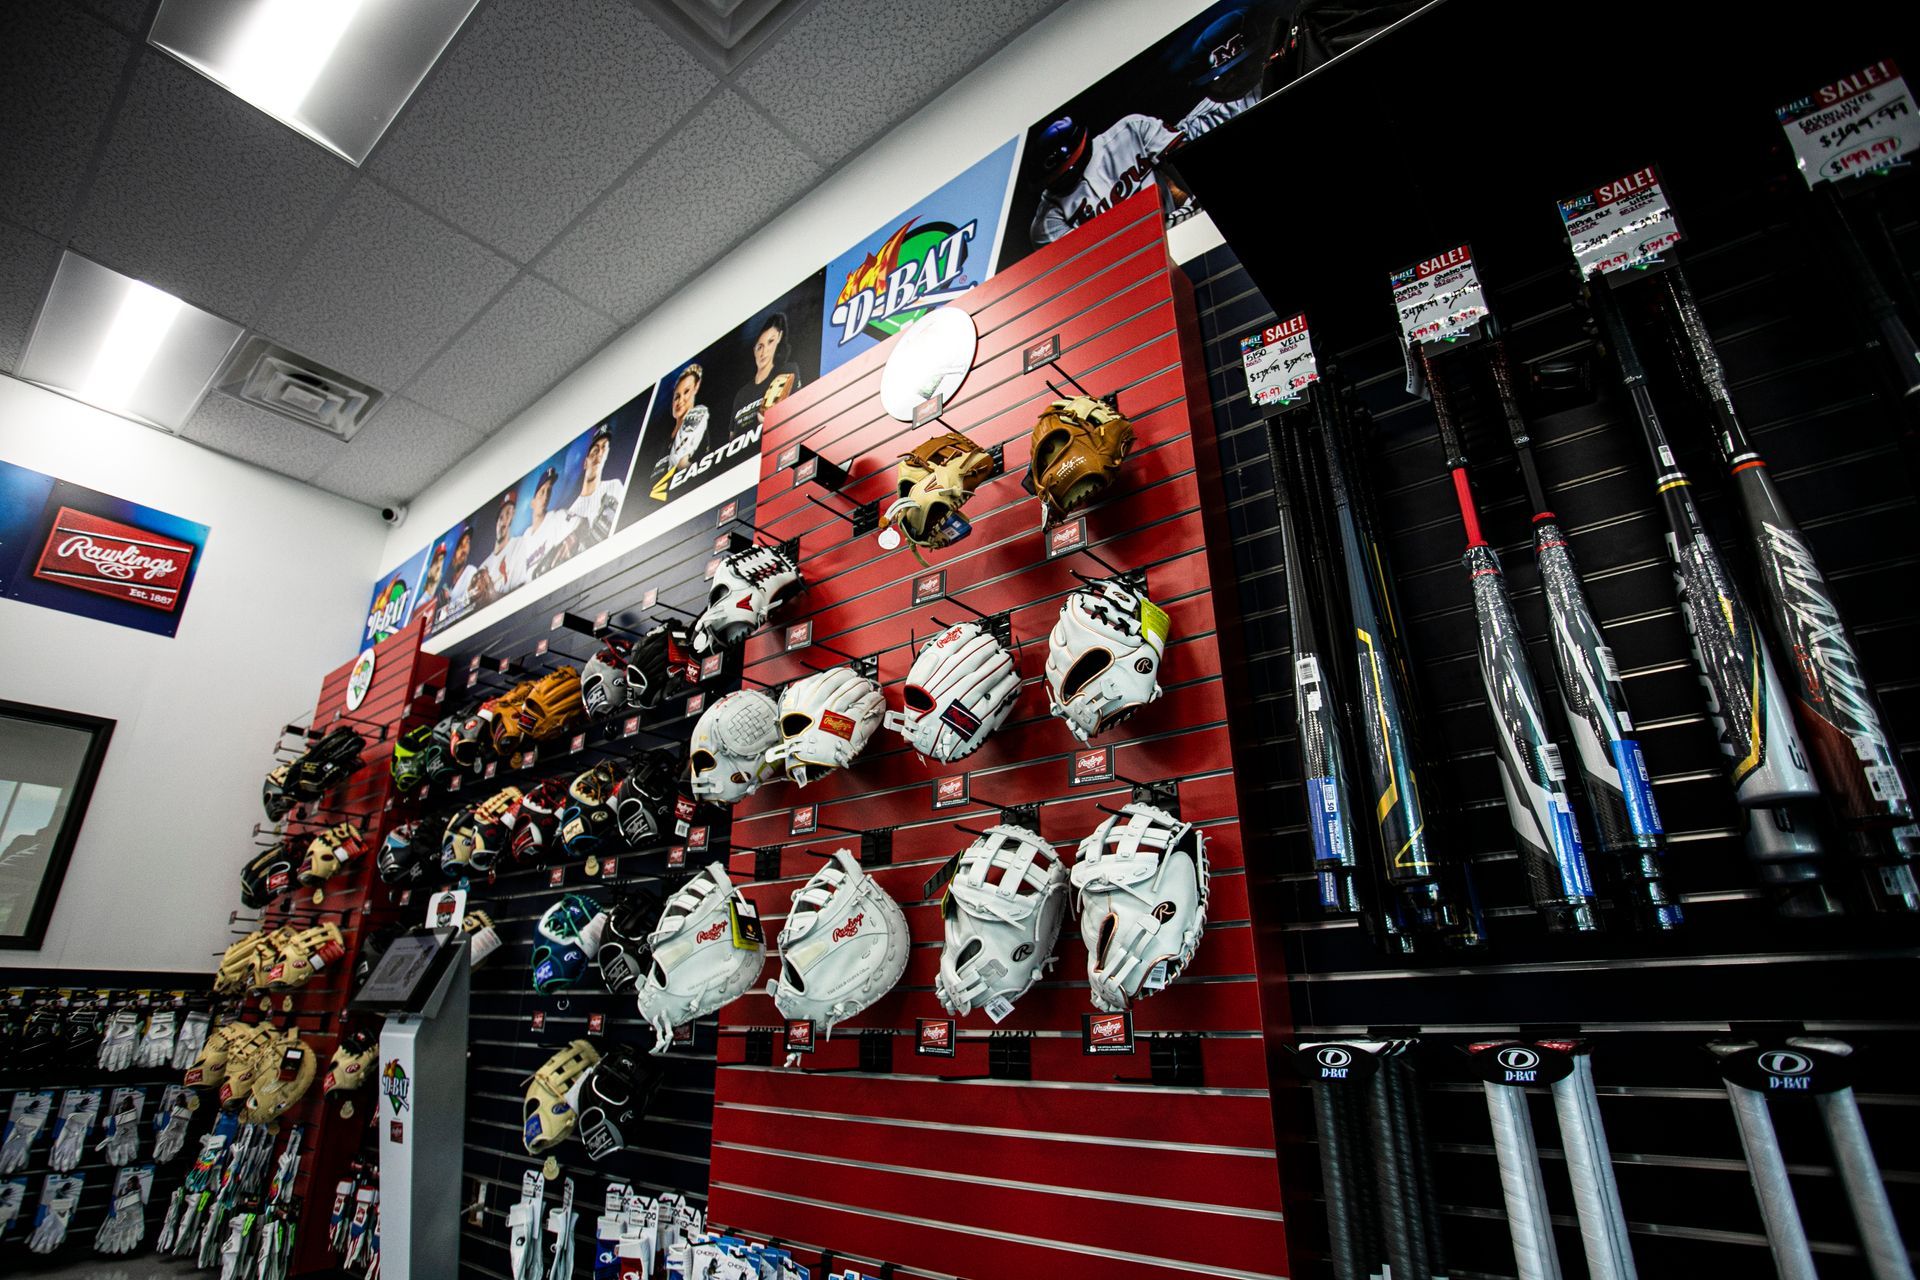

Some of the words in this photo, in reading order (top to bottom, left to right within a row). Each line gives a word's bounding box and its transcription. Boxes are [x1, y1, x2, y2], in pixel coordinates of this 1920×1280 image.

[1819, 61, 1890, 103] SALE!
[1599, 167, 1655, 202] SALE!
[1420, 246, 1465, 275] SALE!
[832, 219, 978, 347] D-BAT
[1265, 315, 1304, 342] SALE!
[1280, 333, 1306, 348] VELO
[1246, 348, 1267, 362] 5150
[668, 423, 764, 491] EASTON
[57, 535, 178, 580] Rawlings
[129, 587, 149, 600] Est.
[150, 593, 173, 605] 1887
[1761, 520, 1890, 749] MAXUM
[1787, 736, 1809, 773] -3
[696, 920, 728, 944] Rawlings
[832, 913, 865, 943] Rawlings
[1321, 1067, 1349, 1078] D-BAT
[1505, 1070, 1537, 1081] D-BAT
[1769, 1076, 1811, 1089] D-BAT
[382, 1075, 410, 1099] D-BAT
